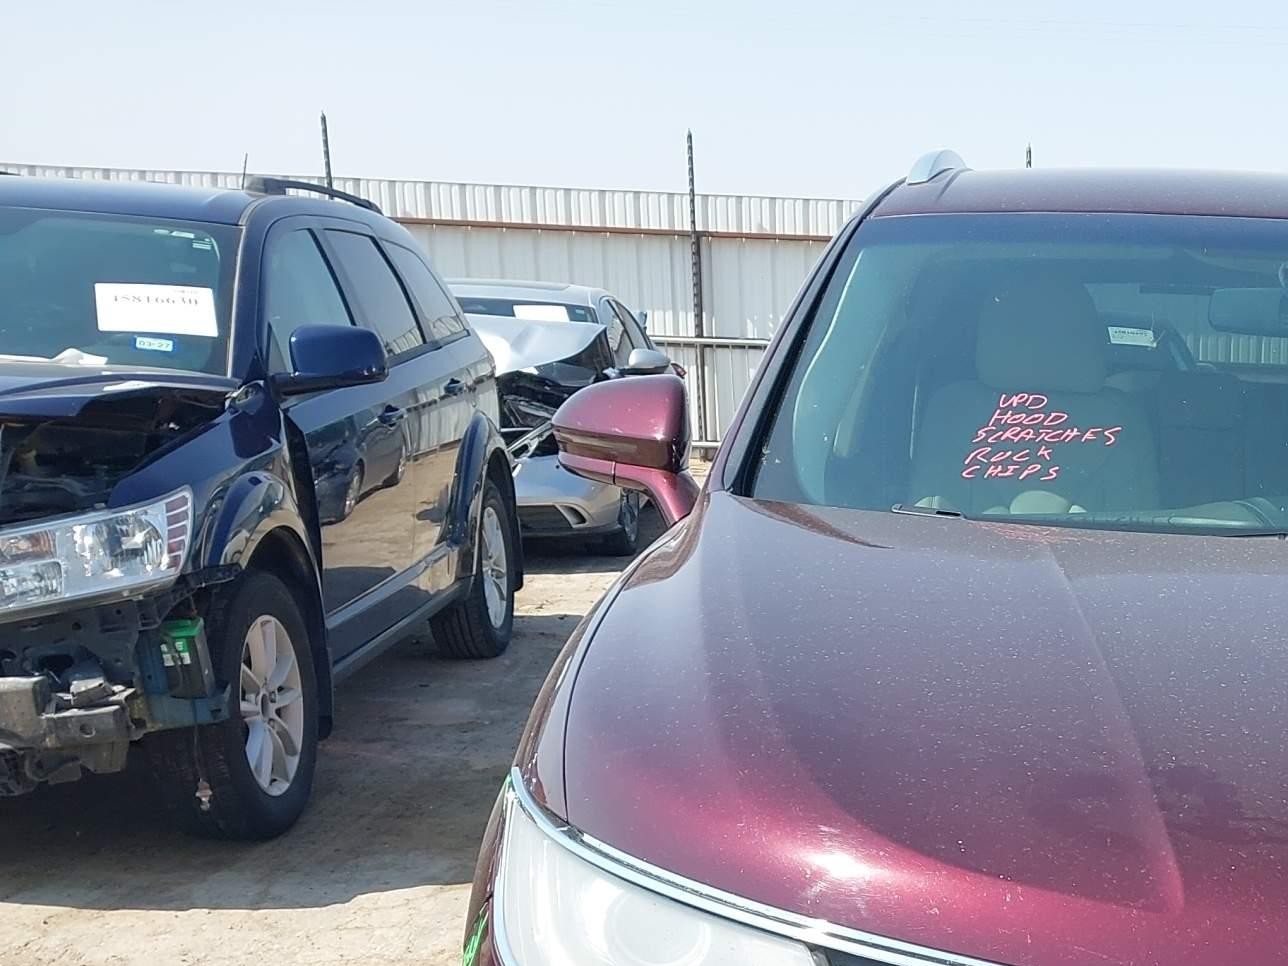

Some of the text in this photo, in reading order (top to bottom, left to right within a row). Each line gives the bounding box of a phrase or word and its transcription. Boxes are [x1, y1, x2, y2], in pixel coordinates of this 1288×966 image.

[1000, 393, 1048, 409] UPD
[988, 409, 1068, 427] HOOD
[972, 426, 1122, 446] SCRATCHES
[964, 446, 1053, 465] ROCK
[961, 464, 1060, 480] CHIPS
